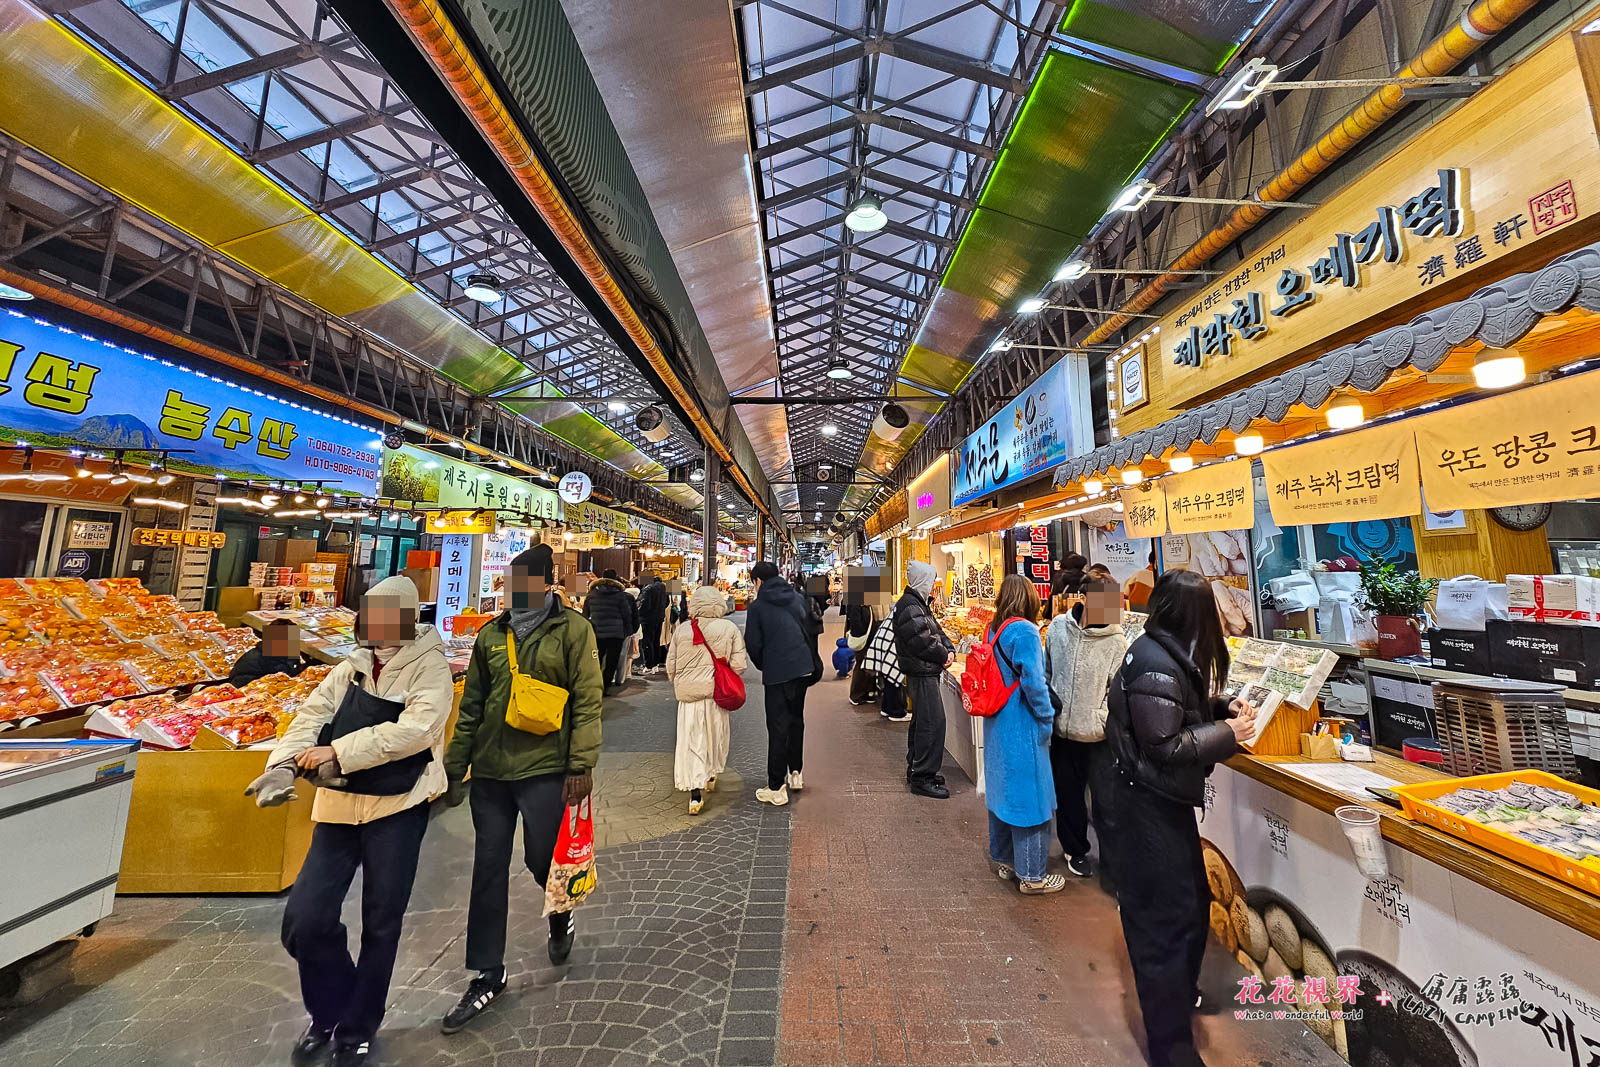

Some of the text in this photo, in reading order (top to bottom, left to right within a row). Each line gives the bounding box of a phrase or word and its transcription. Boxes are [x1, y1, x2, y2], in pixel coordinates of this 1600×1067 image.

[1173, 168, 1463, 369] 제라헌 오메기떡
[1417, 214, 1528, 286] 濟羅軒
[1174, 244, 1286, 329] 제주에서 만든 건강한 먹거리
[158, 388, 299, 460] 농수산
[304, 456, 375, 480] H.010-9086-4143
[307, 437, 376, 464] T.064)752-2938
[1438, 425, 1600, 477] 우도 땅콩 크
[443, 466, 467, 489] 제주
[1276, 459, 1400, 500] 제주 녹차 크림떡
[1172, 487, 1246, 515] 제주 우유 크림떡
[140, 531, 222, 547] 전국택배접수
[478, 516, 492, 527] 크림
[63, 558, 86, 568] ADT
[446, 550, 462, 611] 오메기떡
[1364, 884, 1411, 924] 오메기떡
[1522, 969, 1572, 1006] 제주에서
